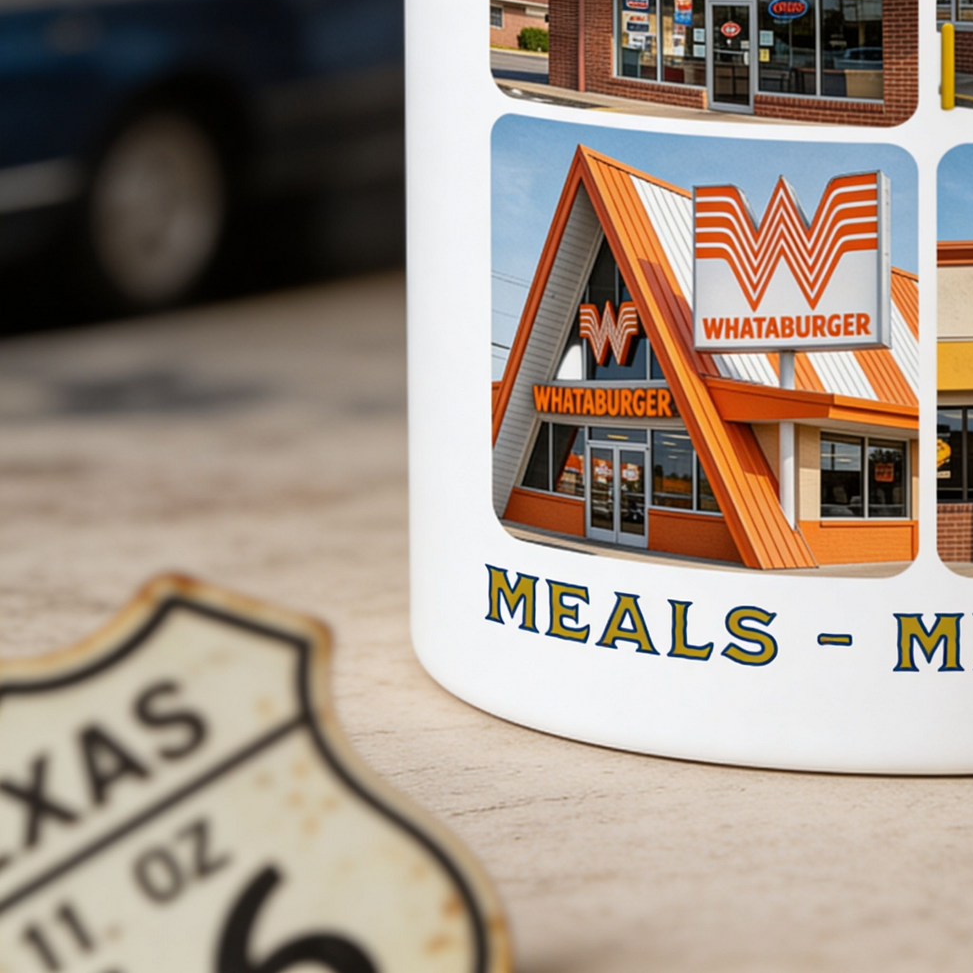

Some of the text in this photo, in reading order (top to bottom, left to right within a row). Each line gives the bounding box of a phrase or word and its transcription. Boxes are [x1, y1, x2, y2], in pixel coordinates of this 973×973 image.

[702, 313, 871, 339] WHATABURGER
[533, 385, 673, 417] WHATABURGER
[484, 563, 779, 667] MEALS
[0, 679, 208, 869] XAS
[132, 817, 233, 907] OZ
